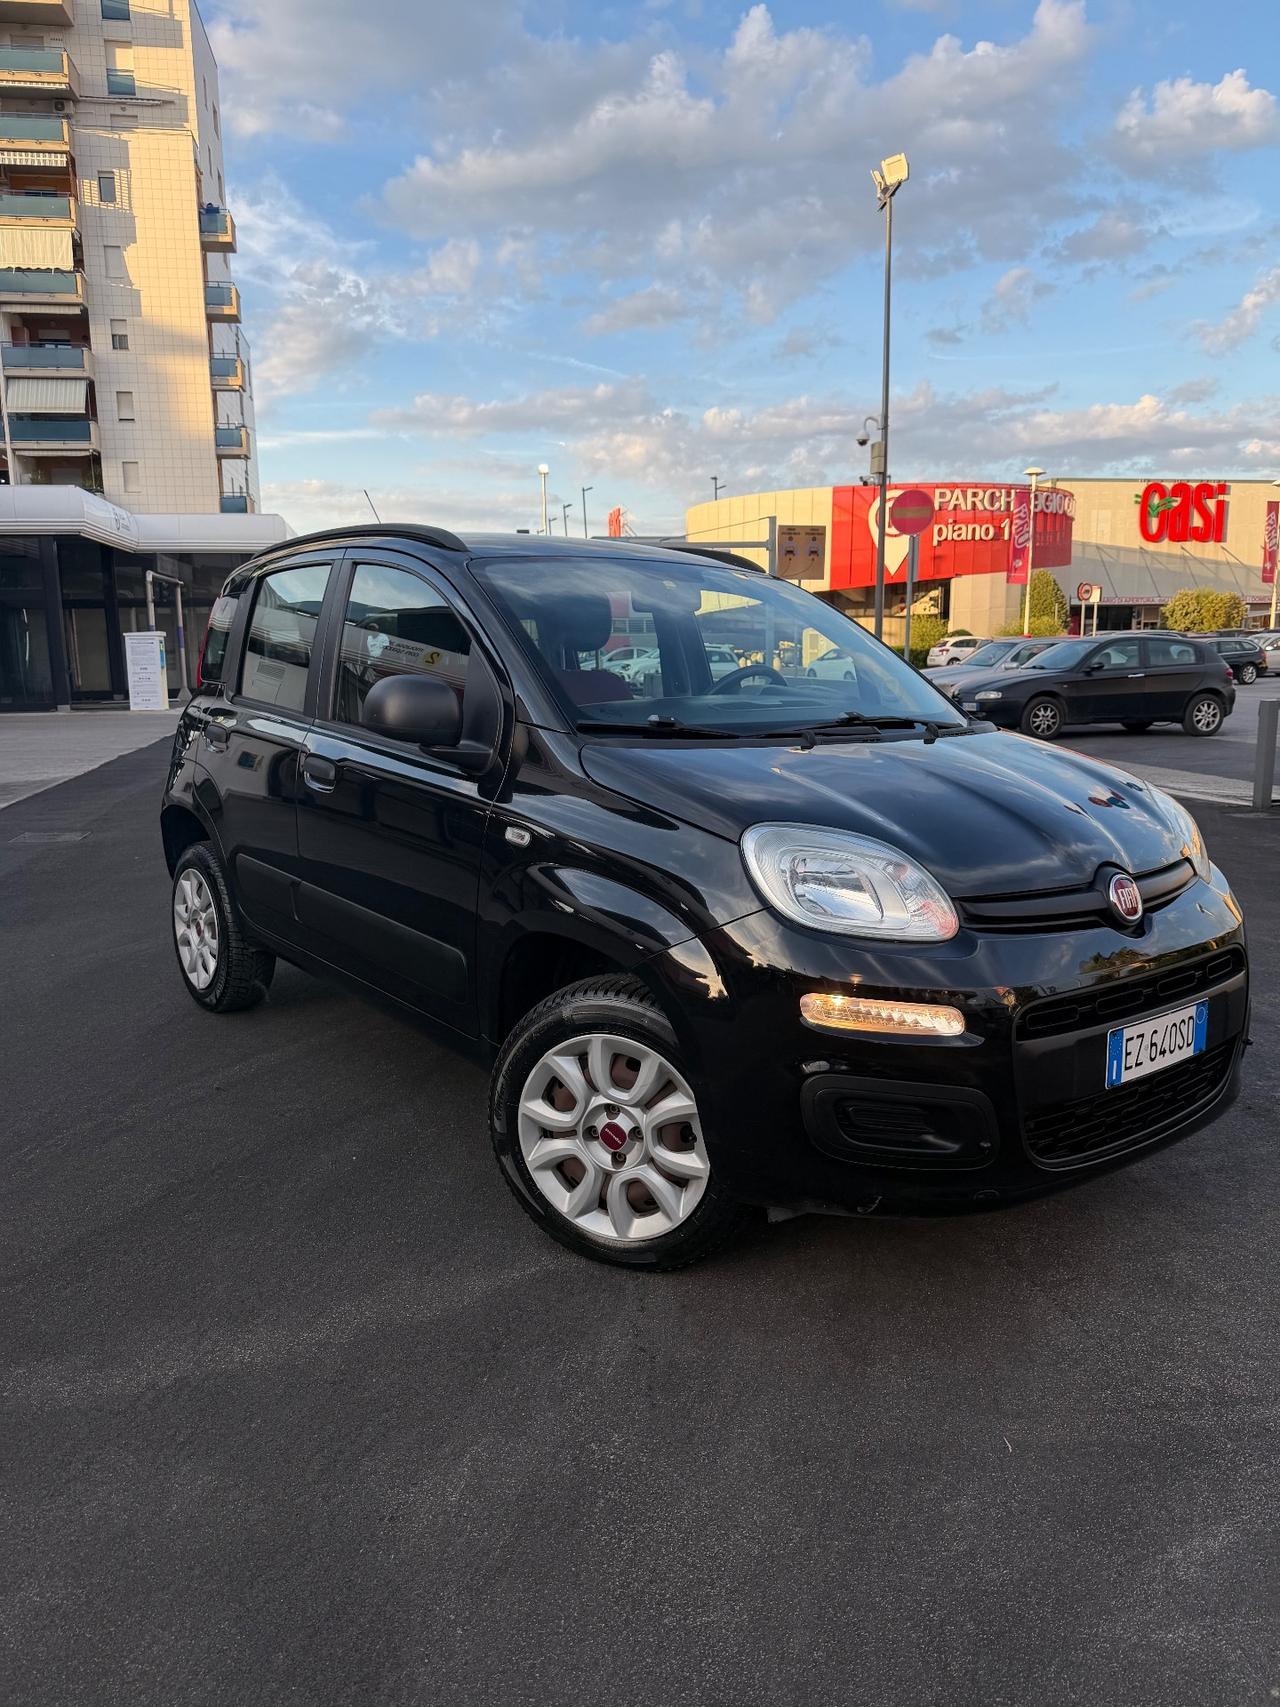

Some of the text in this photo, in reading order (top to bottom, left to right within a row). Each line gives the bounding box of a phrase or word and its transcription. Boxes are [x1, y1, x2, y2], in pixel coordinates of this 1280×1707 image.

[933, 518, 995, 547] piano
[1000, 518, 1011, 541] 1
[1117, 887, 1138, 909] FIAT
[1124, 1032, 1144, 1071] EZ
